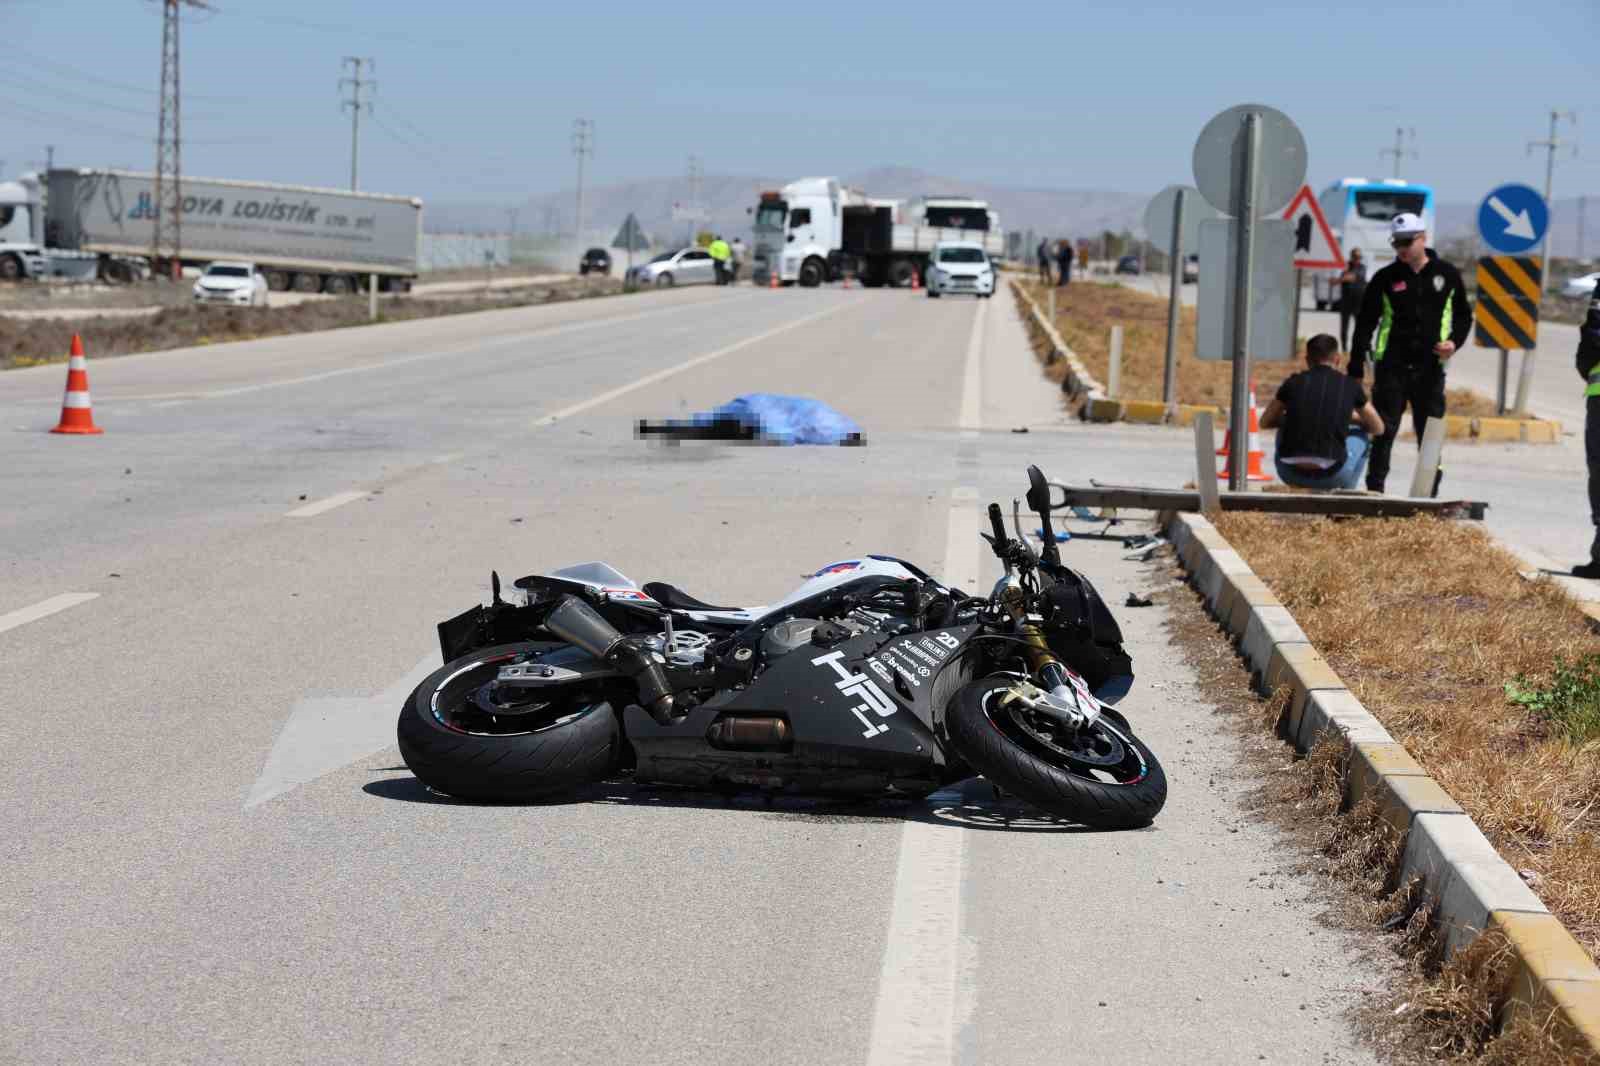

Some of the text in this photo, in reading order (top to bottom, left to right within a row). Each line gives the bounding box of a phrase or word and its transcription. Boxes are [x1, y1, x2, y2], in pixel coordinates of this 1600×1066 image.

[231, 195, 322, 224] LOJİSTİK
[936, 631, 960, 649] 2D
[888, 656, 920, 686] brembo
